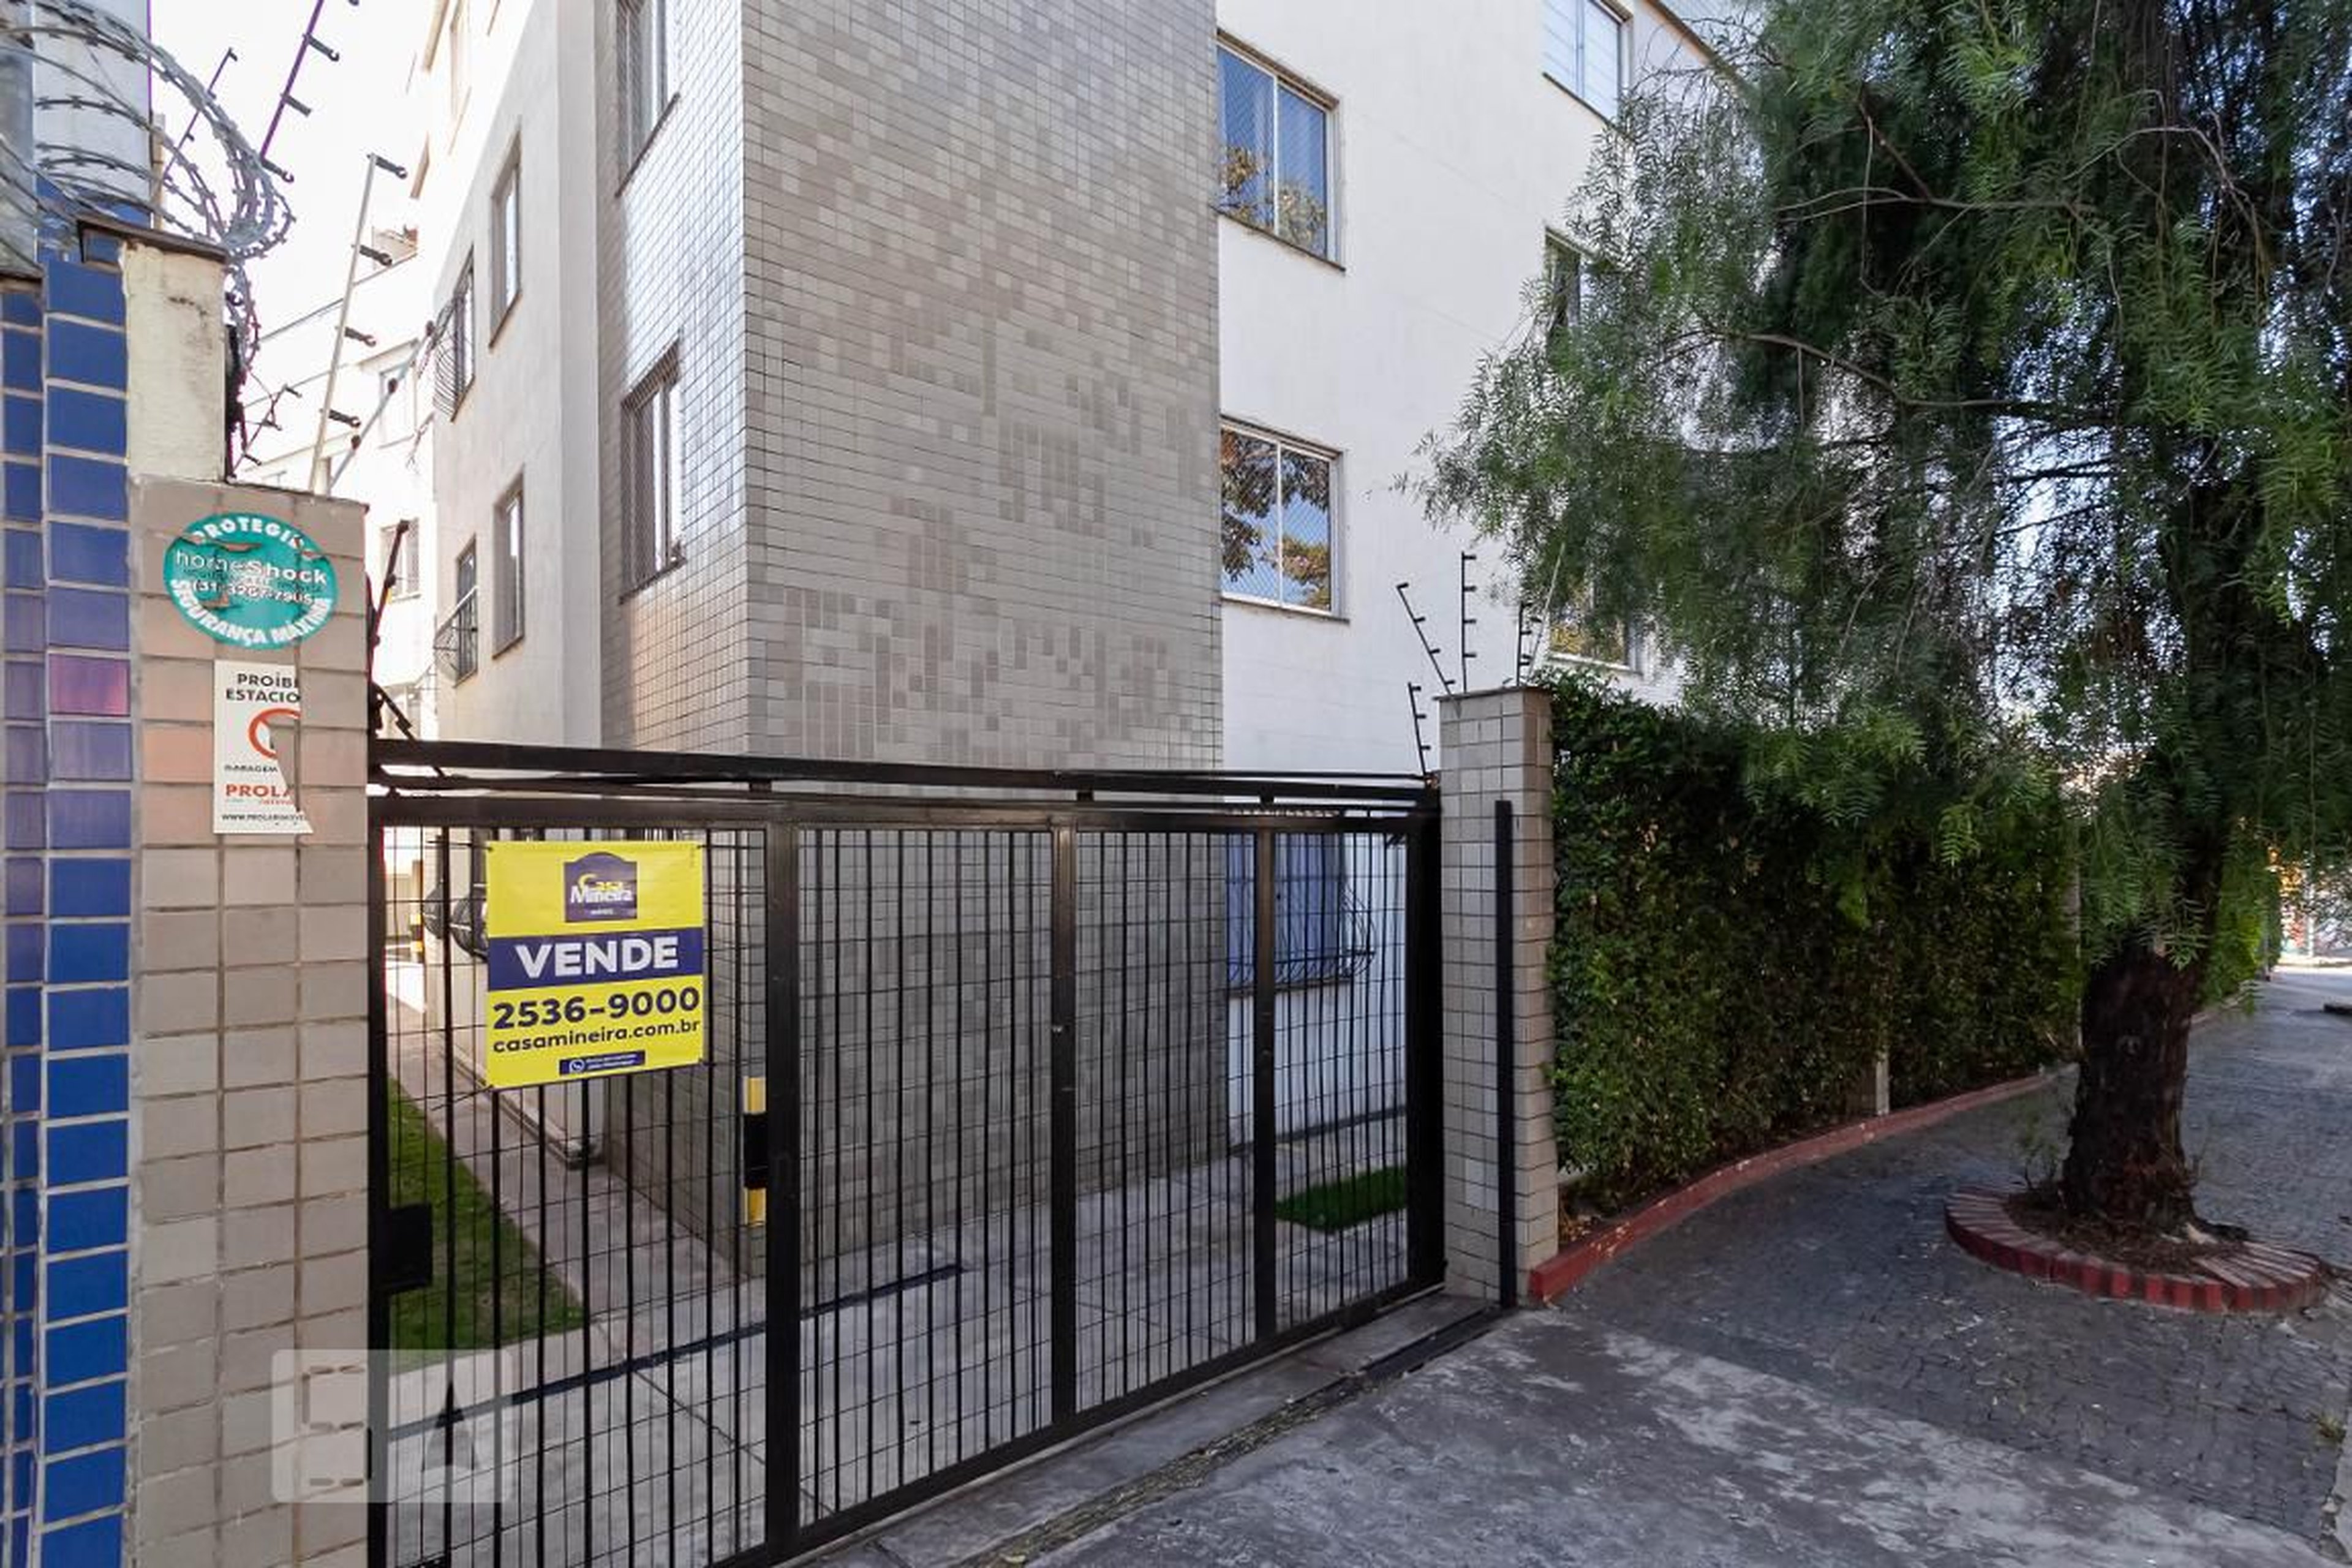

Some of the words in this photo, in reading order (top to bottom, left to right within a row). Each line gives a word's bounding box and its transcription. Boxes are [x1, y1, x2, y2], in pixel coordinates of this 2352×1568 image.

[515, 936, 679, 979] VENDE
[493, 986, 700, 1030] 2536-9000
[493, 1019, 701, 1053] casamineira.com.br
